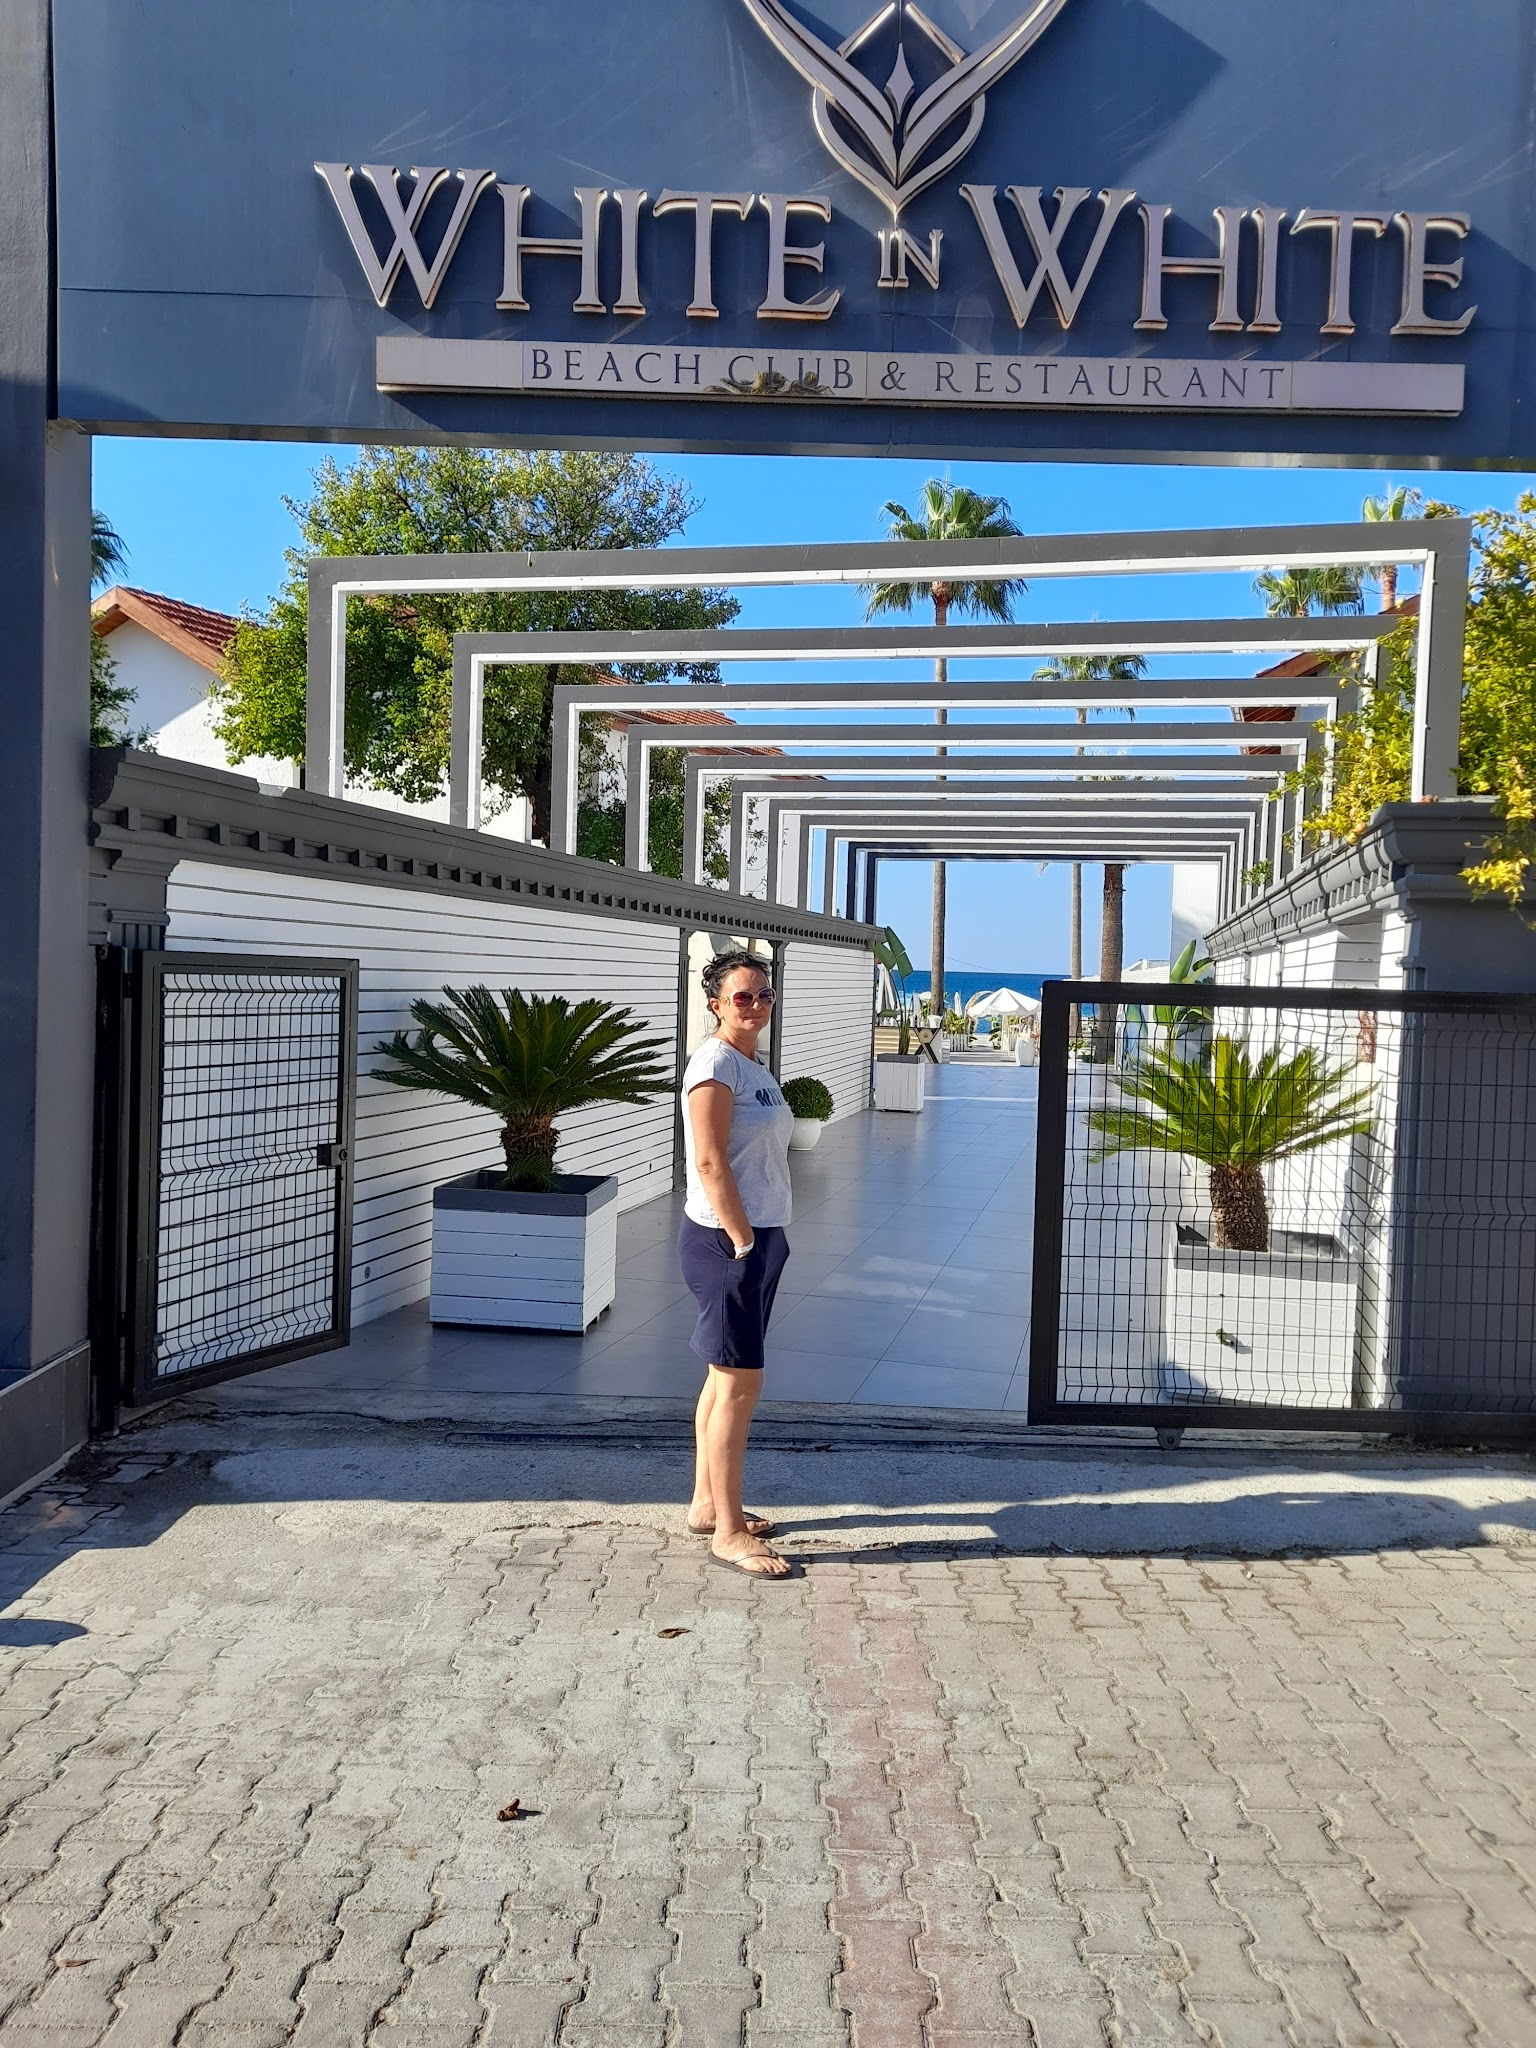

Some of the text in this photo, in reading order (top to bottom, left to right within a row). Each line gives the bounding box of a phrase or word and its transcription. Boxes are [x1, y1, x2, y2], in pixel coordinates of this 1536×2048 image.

[314, 161, 1478, 335] WHITE IN WHITE
[531, 349, 700, 385] BEACH
[880, 361, 907, 391] &
[934, 361, 1285, 399] RESTAURANT
